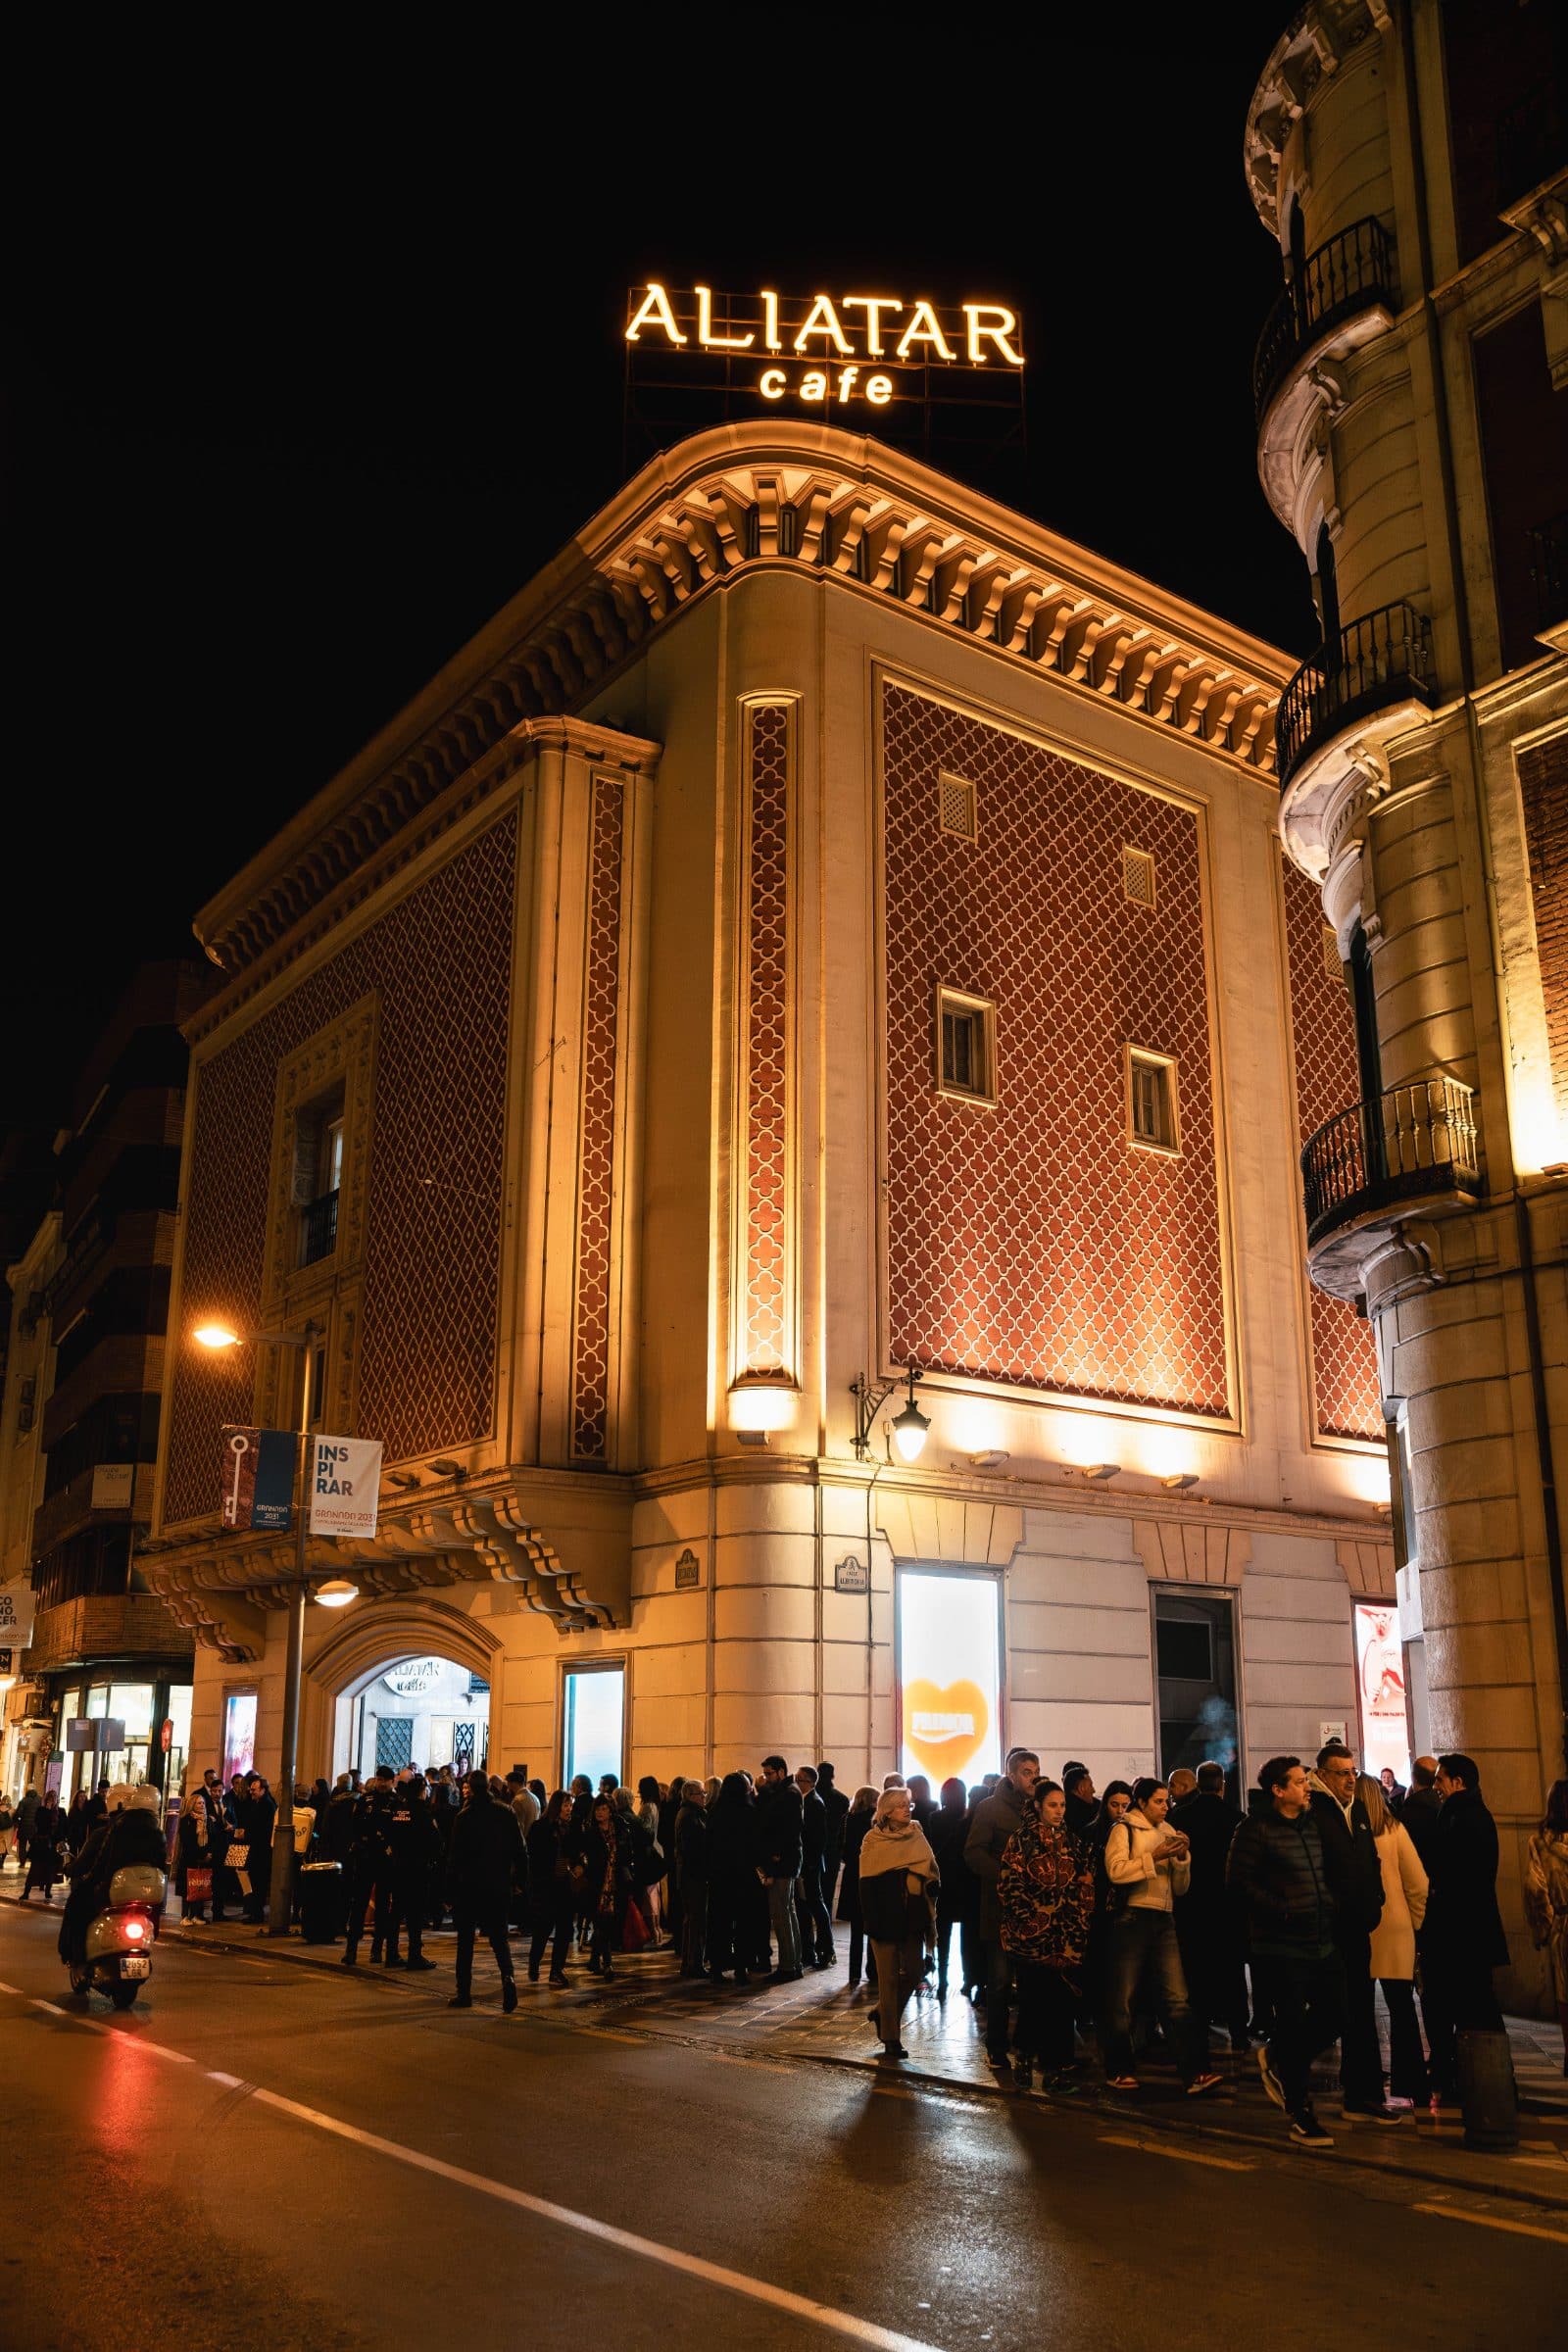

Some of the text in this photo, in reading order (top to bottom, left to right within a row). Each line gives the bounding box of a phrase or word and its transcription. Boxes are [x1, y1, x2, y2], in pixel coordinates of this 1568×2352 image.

[624, 282, 1025, 366] ALIATAR
[759, 367, 894, 404] cafe
[318, 1444, 349, 1463] INS
[317, 1462, 334, 1478] PI
[316, 1478, 353, 1496] RAR
[264, 1512, 280, 1521] 2031
[315, 1509, 357, 1520] GRANADA
[0, 1616, 17, 1625] ER
